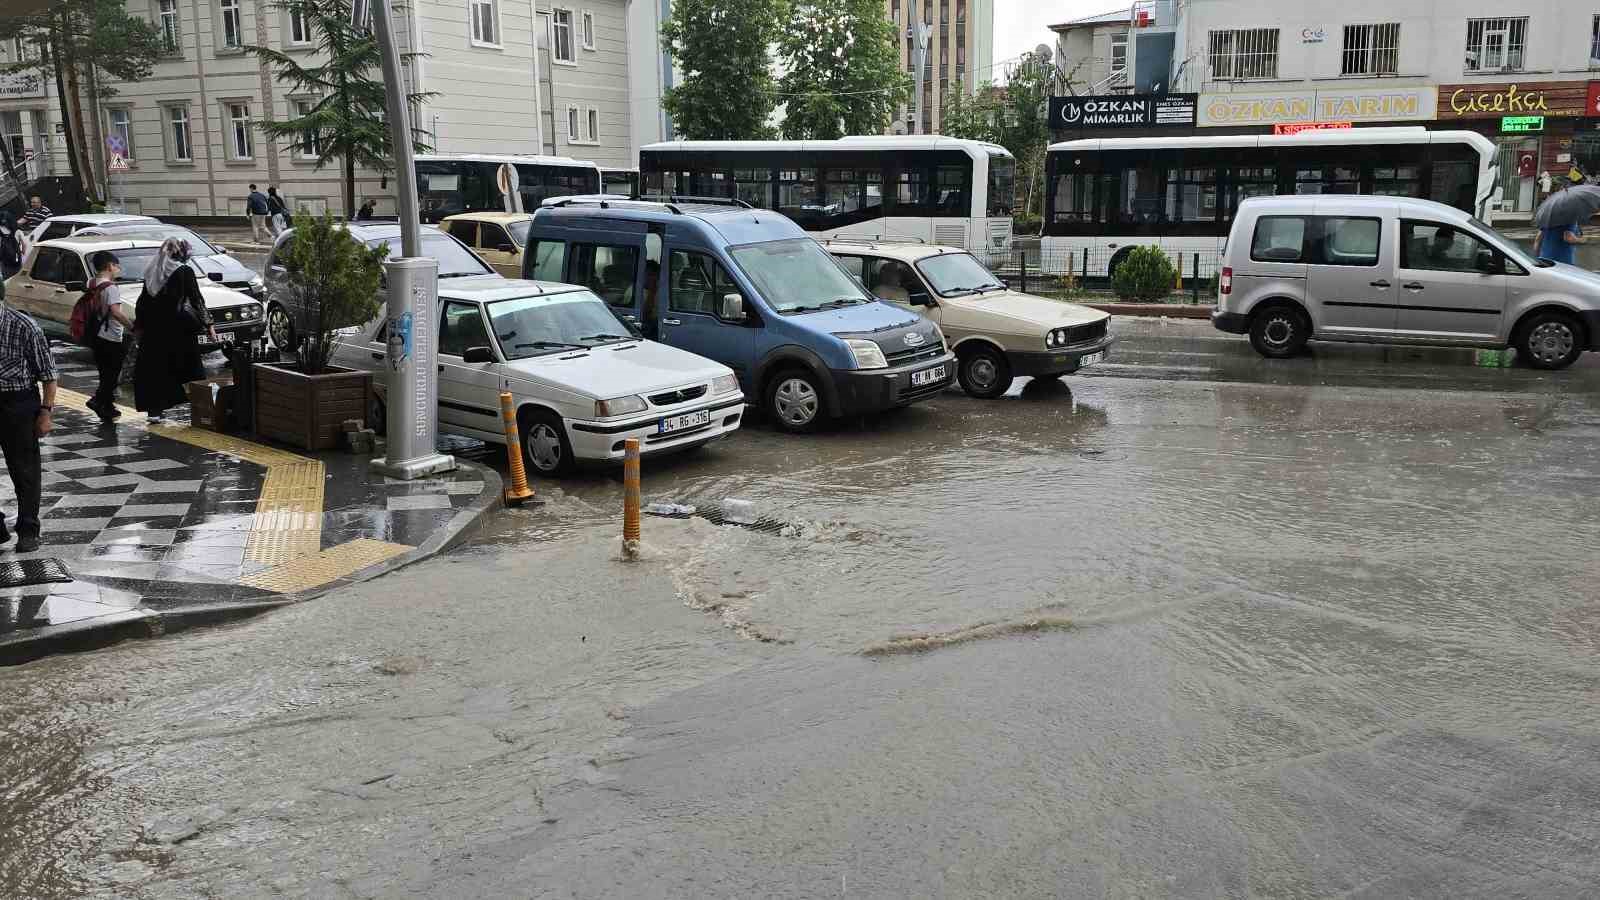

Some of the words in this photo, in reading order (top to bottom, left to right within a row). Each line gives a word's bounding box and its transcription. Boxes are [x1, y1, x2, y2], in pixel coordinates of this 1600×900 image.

[1084, 99, 1145, 112] ÖZKAN
[1208, 97, 1308, 120] ÖZKAN
[1319, 95, 1418, 117] TARIM
[1451, 84, 1547, 115] Çiçekçi
[1083, 113, 1144, 124] MİMARLIK
[664, 417, 673, 431] 34
[680, 415, 688, 428] RG
[696, 411, 707, 424] 316
